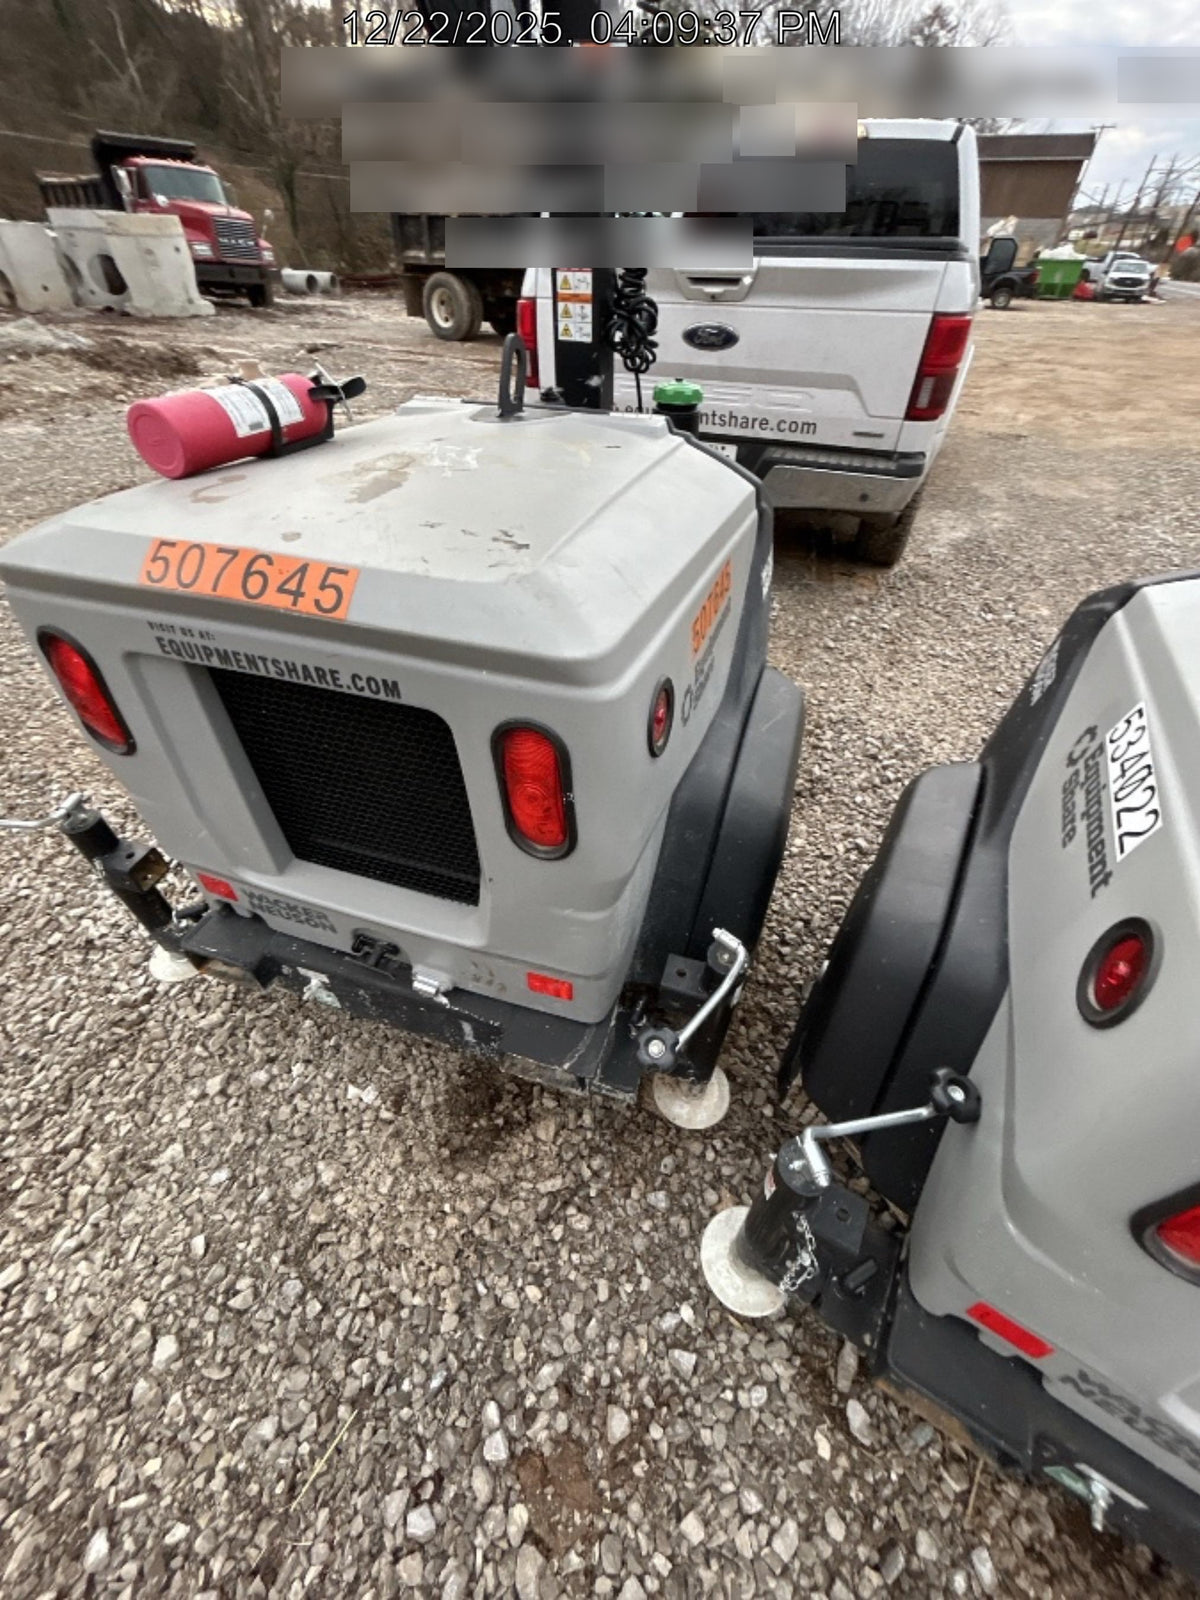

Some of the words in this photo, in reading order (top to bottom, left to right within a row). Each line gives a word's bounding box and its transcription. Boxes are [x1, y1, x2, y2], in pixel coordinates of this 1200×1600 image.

[146, 540, 349, 614] 507645
[155, 636, 402, 699] EQUIPMENTSHARE.COM
[1061, 767, 1080, 849] Share
[1082, 741, 1113, 899] Equipment
[1109, 707, 1160, 855] 534022
